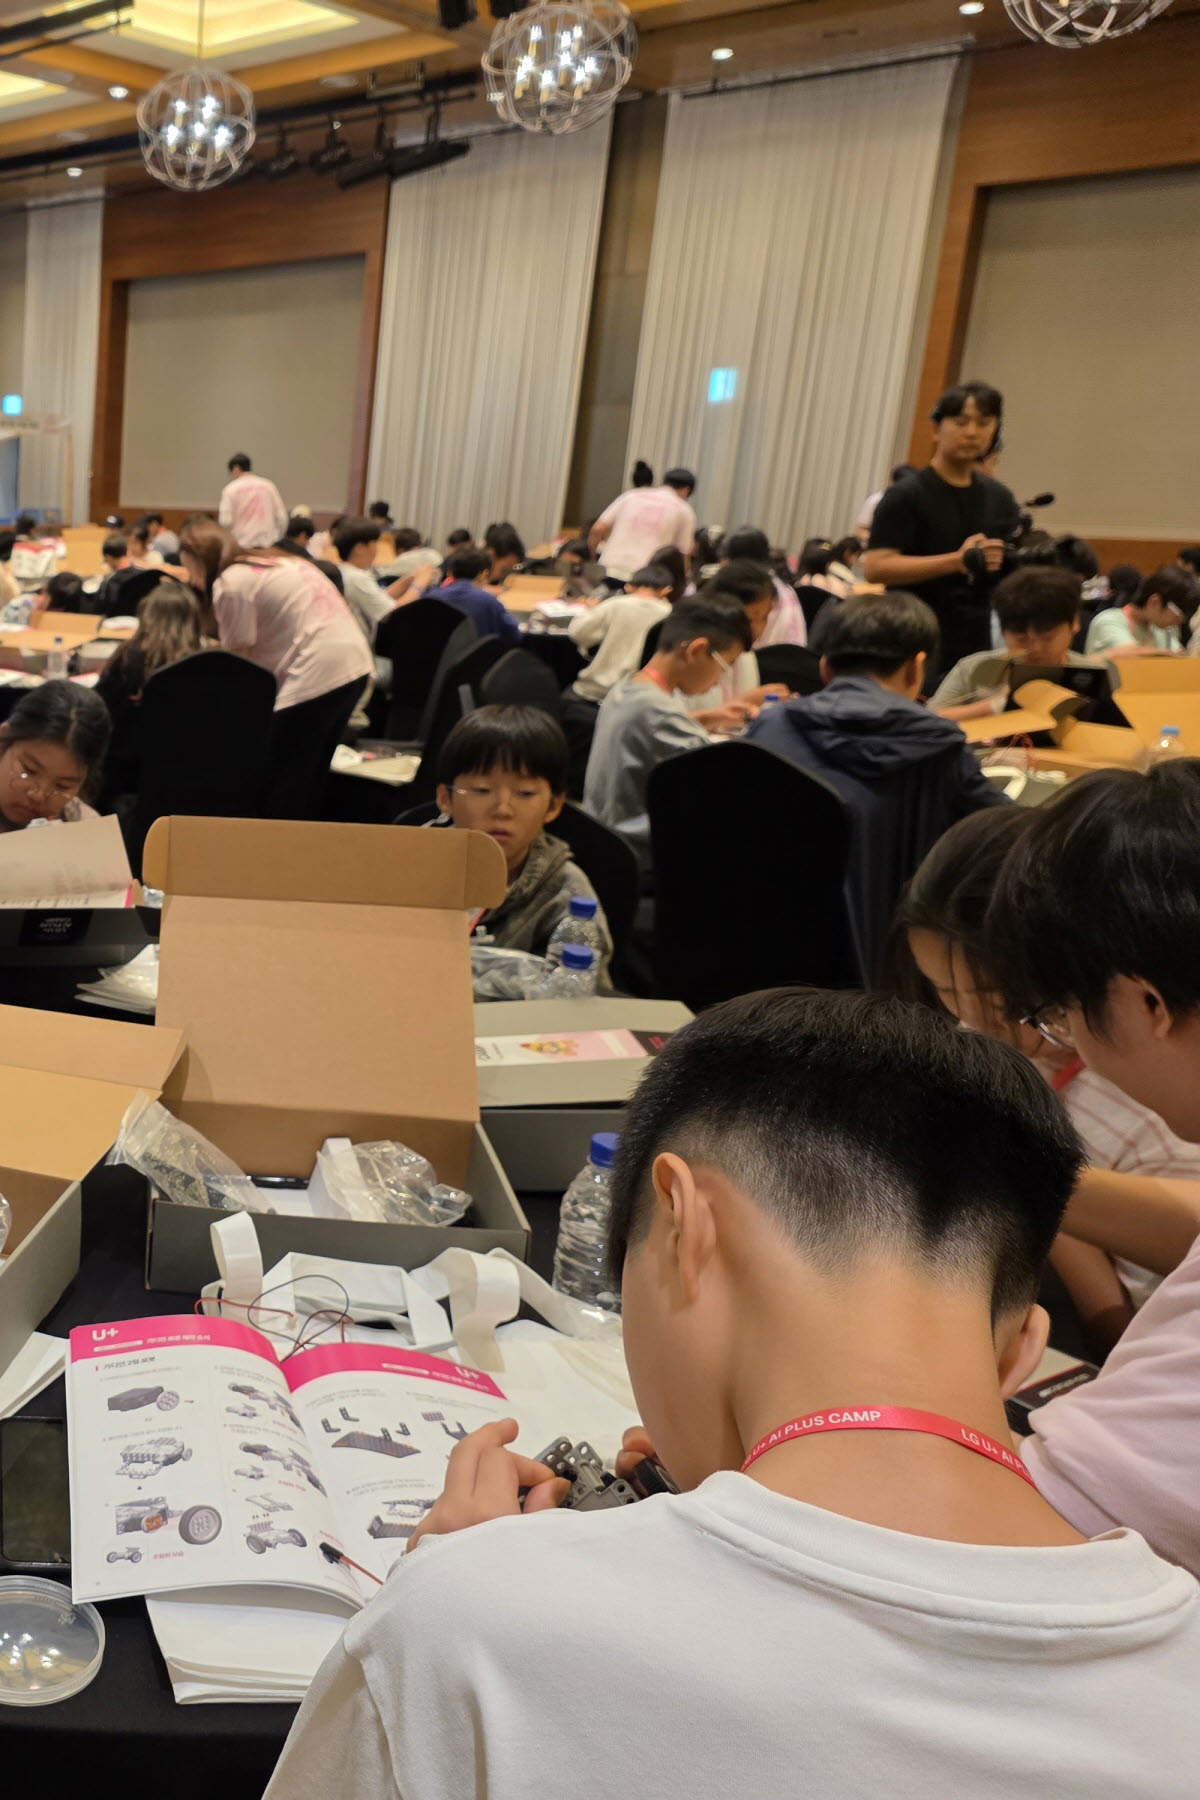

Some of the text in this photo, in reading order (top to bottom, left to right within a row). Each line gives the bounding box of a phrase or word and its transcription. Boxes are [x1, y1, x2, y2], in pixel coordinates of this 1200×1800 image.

[92, 1328, 118, 1341] U+
[752, 1410, 882, 1459] U+ AI PLUS CAMP
[960, 1428, 980, 1447] LG
[980, 1438, 1000, 1457] U+
[1001, 1449, 1014, 1464] AI
